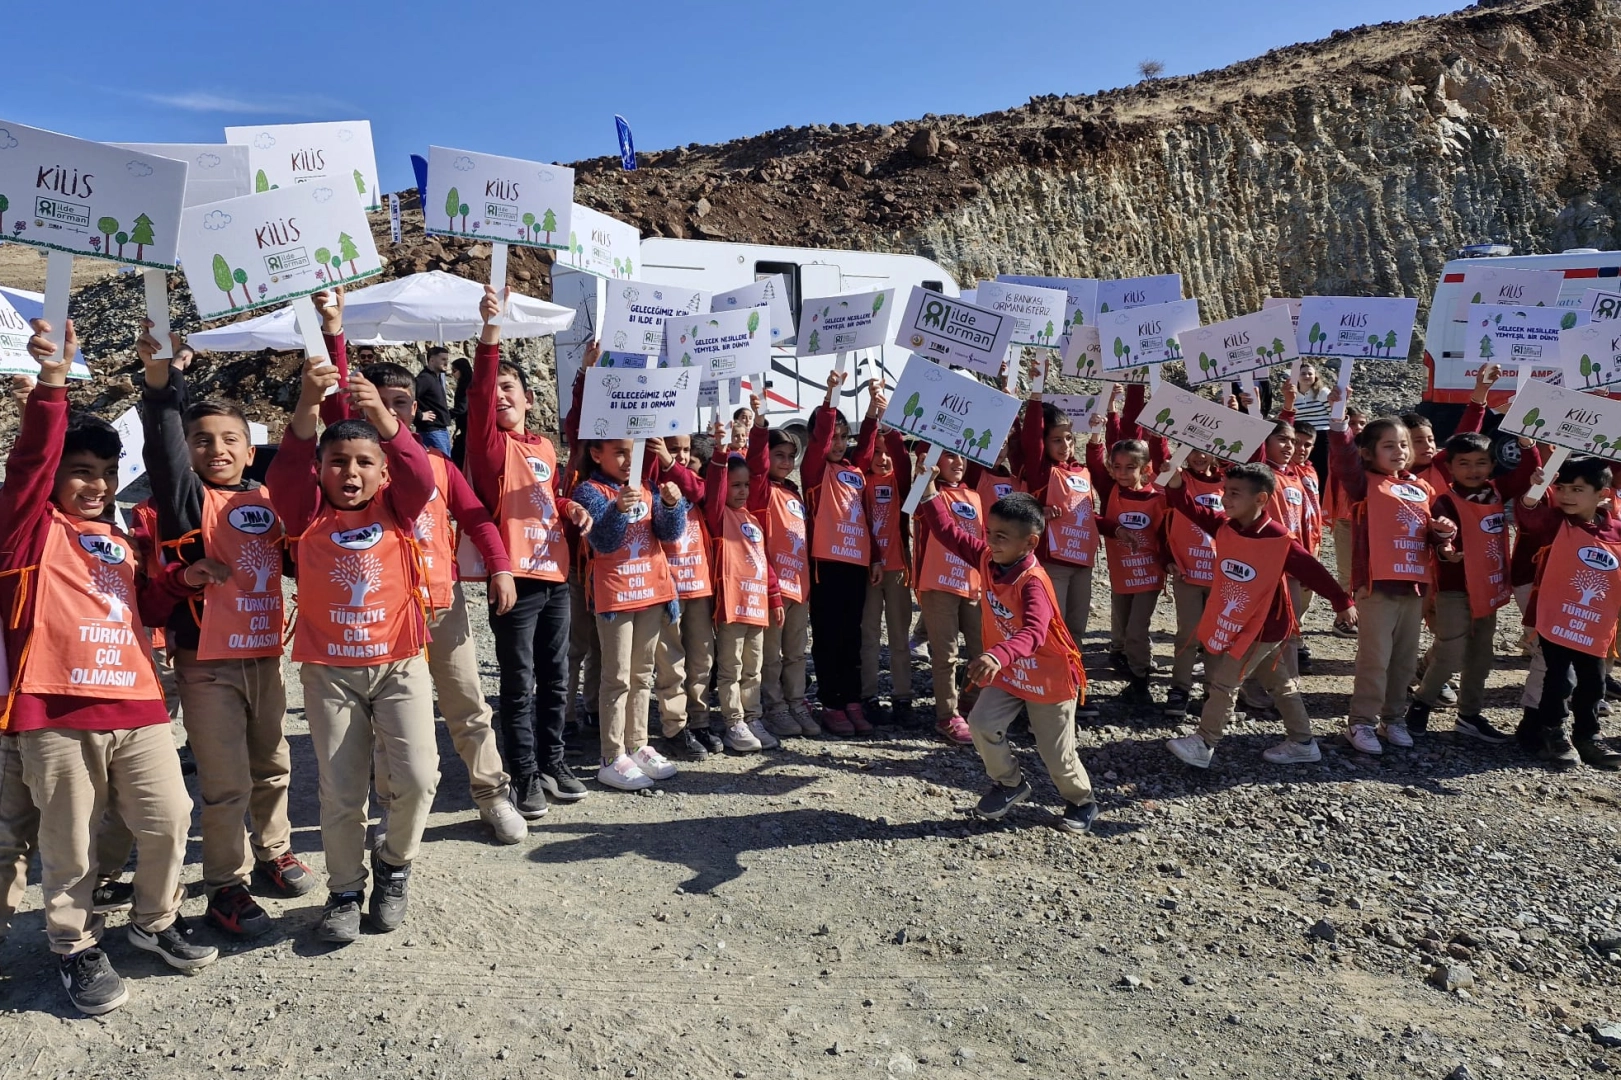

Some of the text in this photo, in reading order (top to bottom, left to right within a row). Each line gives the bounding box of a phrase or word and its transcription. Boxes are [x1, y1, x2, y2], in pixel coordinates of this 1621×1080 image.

[291, 148, 325, 171] KİLİS
[36, 165, 95, 199] KİLİS
[485, 178, 520, 201] KİLİS
[56, 213, 87, 223] orman
[255, 218, 300, 249] KİLİS
[1123, 289, 1146, 303] KİLİS
[1498, 283, 1526, 299] KİLİS
[951, 307, 977, 326] ilde
[1340, 311, 1369, 328] KİLİS
[946, 325, 990, 346] orman
[1138, 320, 1162, 337] KİLİS
[1223, 331, 1250, 349] KİLİS
[611, 389, 677, 401] GELECEĞİMİZ İÇİN
[610, 399, 676, 410] 81 İLDE 81 ORMAN
[940, 393, 973, 416] KİLİS
[1191, 412, 1223, 430] KİLİS
[1564, 408, 1603, 426] KİLİS
[836, 521, 865, 538] TÜRKİYE
[1060, 526, 1091, 540] TÜRKİYE
[843, 534, 857, 547] ÇÖL
[831, 544, 862, 559] OLMASIN
[1587, 549, 1608, 563] TEMA
[677, 566, 695, 582] ÇÖL
[1226, 561, 1244, 575] TEMA
[235, 594, 280, 612] TÜRKİYE
[616, 587, 655, 602] OLMASIN
[329, 607, 386, 625] TÜRKİYE
[1562, 603, 1602, 623] TÜRKİYE
[249, 612, 270, 634] ÇÖL
[1568, 617, 1587, 631] ÇÖL
[79, 622, 137, 646] TÜRKİY
[228, 632, 279, 649] OLMASIN
[343, 626, 371, 644] ÇÖL
[1551, 625, 1594, 647] OLMASIN
[95, 645, 122, 668] ÇÖL
[327, 642, 389, 658] OLMASIN
[70, 667, 137, 687] OLMASIN
